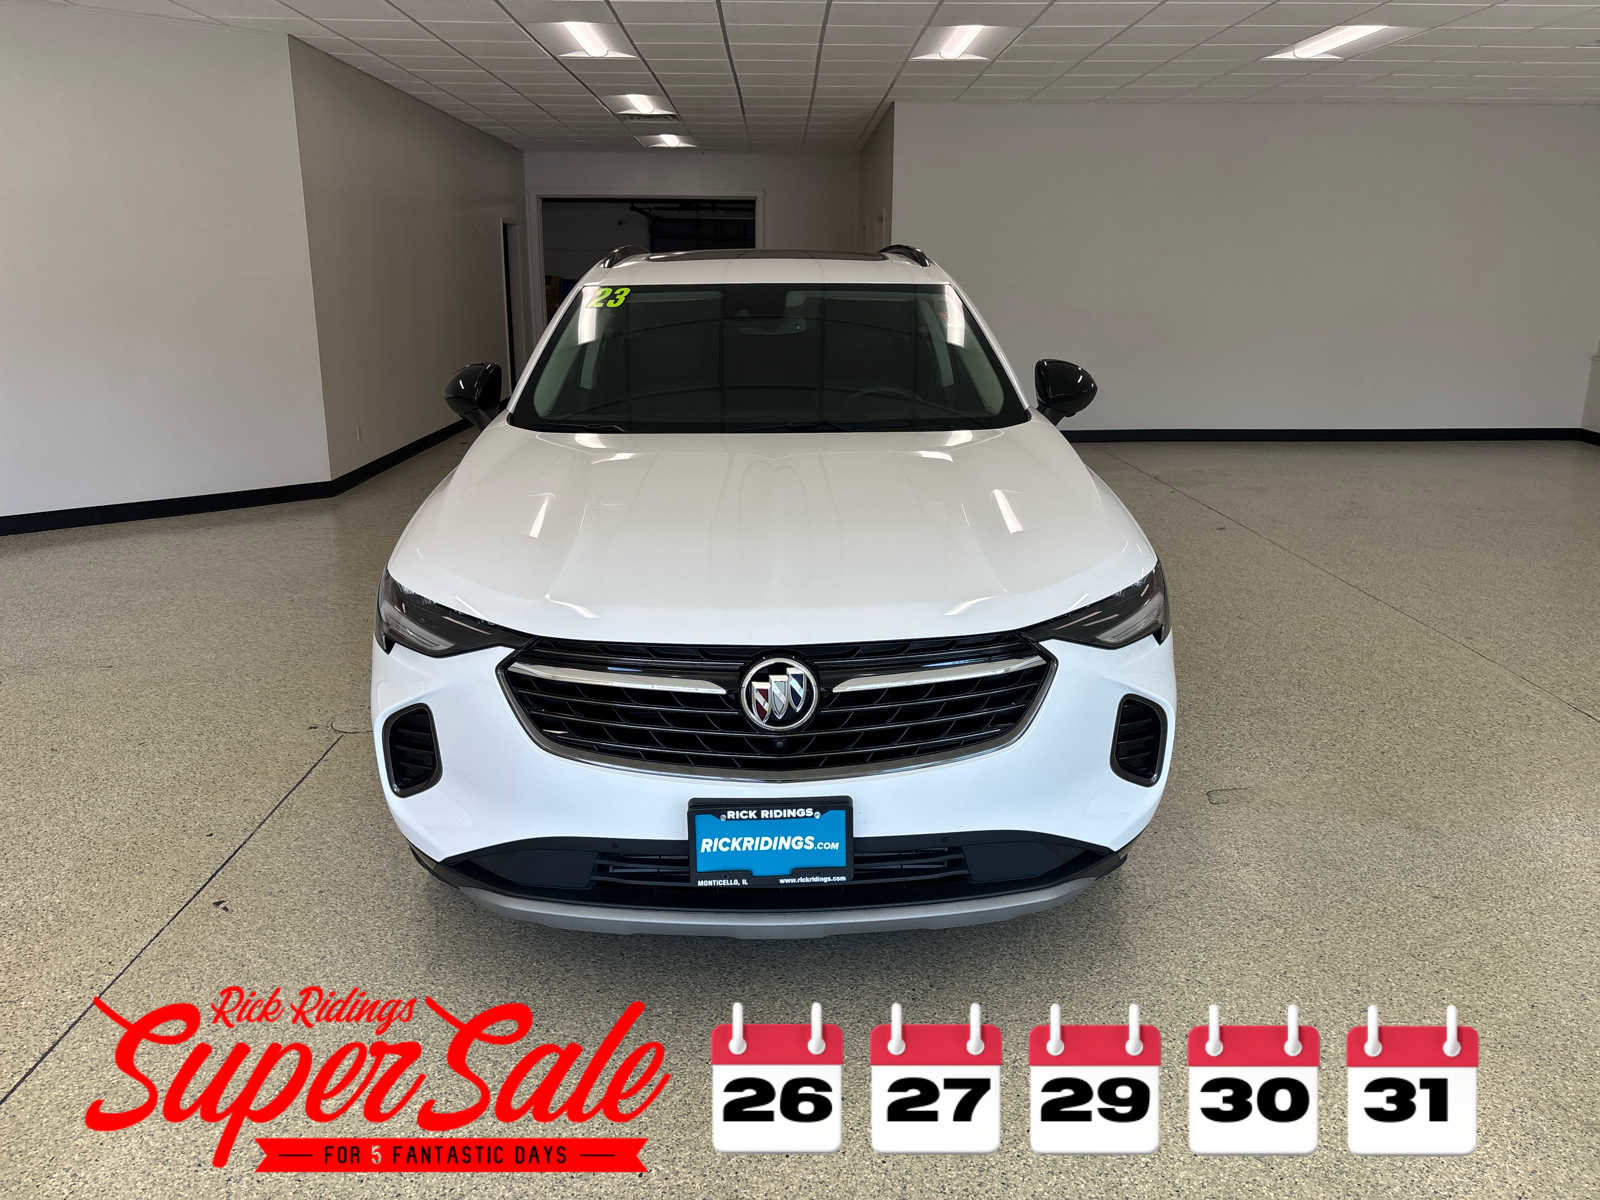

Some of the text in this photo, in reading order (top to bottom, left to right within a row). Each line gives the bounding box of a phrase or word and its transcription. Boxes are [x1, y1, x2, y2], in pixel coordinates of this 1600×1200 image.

[727, 808, 813, 820] RICK RIDINGS
[779, 876, 846, 884] www.rickridings.com
